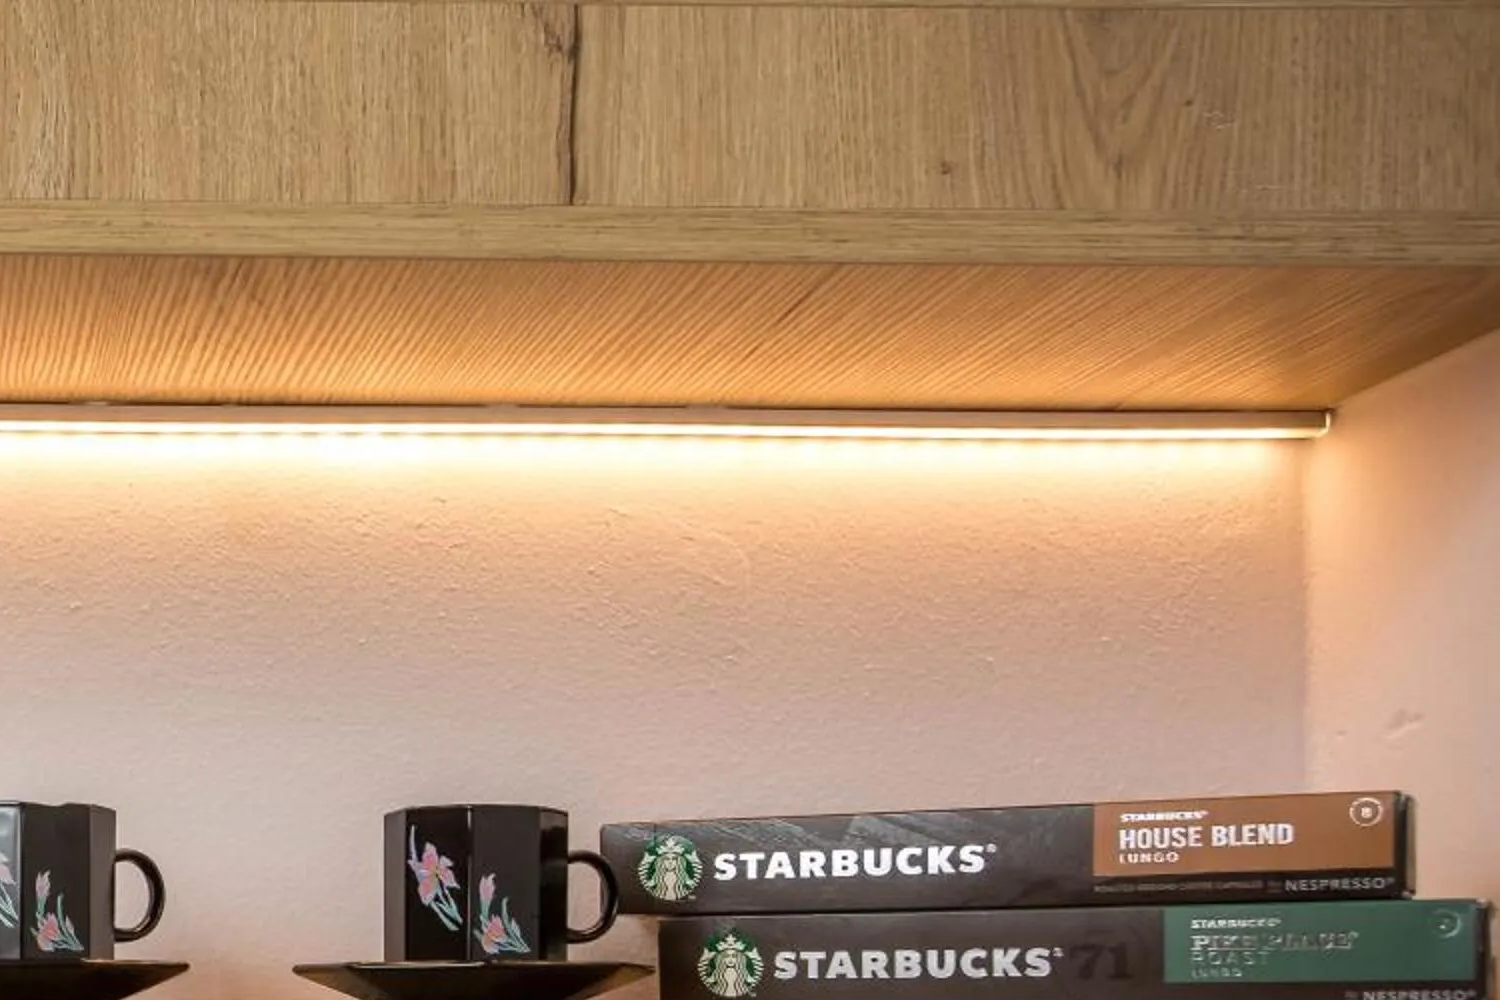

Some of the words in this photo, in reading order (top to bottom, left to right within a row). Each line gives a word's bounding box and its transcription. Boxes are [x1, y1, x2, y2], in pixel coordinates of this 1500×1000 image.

[1118, 826, 1204, 850] HOUSE
[1211, 823, 1295, 848] BLEND
[713, 844, 986, 881] STARBUCKS
[1118, 851, 1180, 865] LUNGO
[1284, 877, 1387, 893] NESPRESSO
[773, 947, 1053, 980] STARBUCKS
[1069, 941, 1136, 981] 71
[1190, 950, 1271, 966] ROAST
